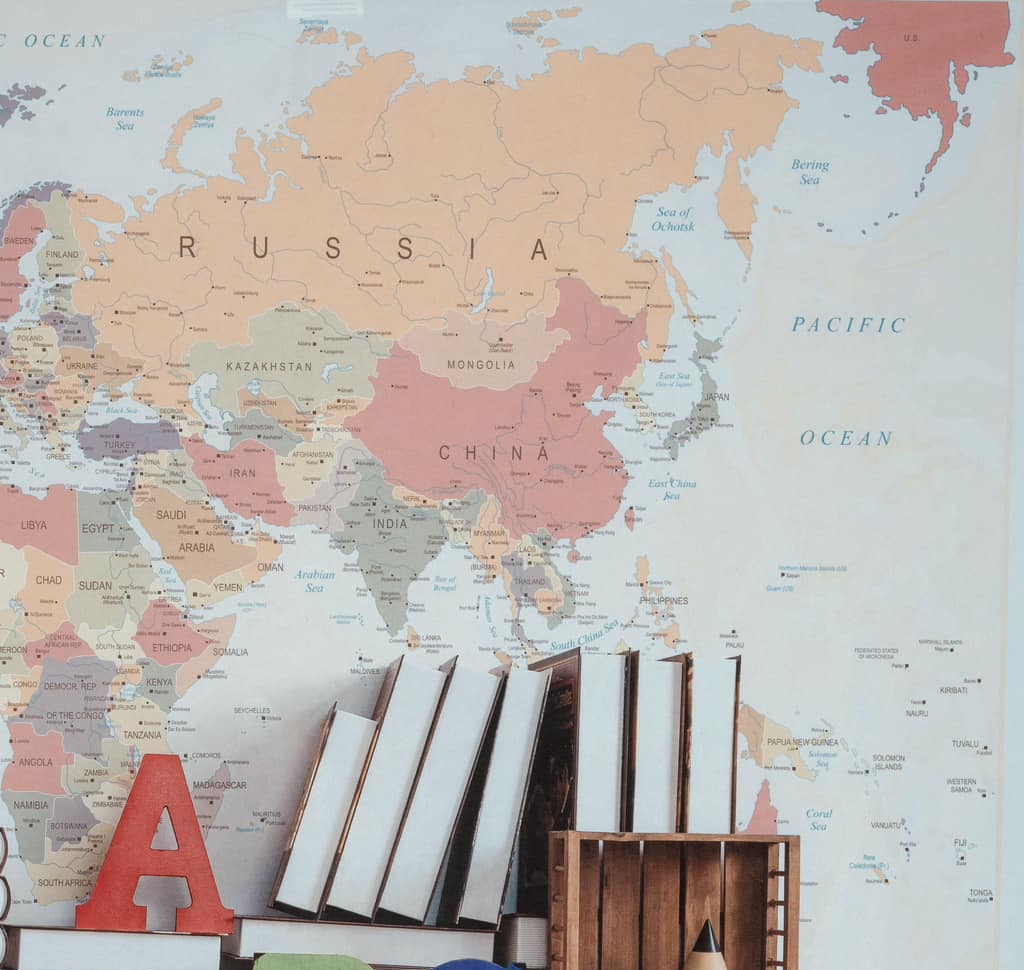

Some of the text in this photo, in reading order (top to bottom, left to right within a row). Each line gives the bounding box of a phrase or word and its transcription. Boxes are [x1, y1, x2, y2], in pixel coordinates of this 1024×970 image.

[24, 33, 107, 48] OCEAN
[106, 107, 144, 118] Barents
[116, 120, 134, 131] Sea
[792, 158, 830, 173] Bering
[800, 174, 820, 185] Sea
[657, 206, 693, 219] Sea of
[652, 220, 696, 233] Ochotsk
[179, 235, 548, 260] RUSSIA
[45, 251, 79, 259] FINLAND
[792, 316, 906, 333] PACIFIC
[226, 362, 313, 372] KAZAKHSTAN
[448, 361, 515, 369] MONGOLIA
[800, 430, 893, 446] OCEAN
[104, 441, 135, 449] TURKEY
[439, 445, 548, 461] CHINA
[230, 469, 256, 478] IRAN
[648, 479, 697, 488] East China
[664, 492, 680, 501] Sea
[298, 504, 332, 512] PAKISTAN
[156, 510, 186, 520] SAUDI
[21, 520, 47, 530] LIBYA
[373, 519, 408, 529] INDIA
[82, 524, 114, 534] EGYPT
[179, 543, 215, 553] ARABIA
[257, 563, 284, 572] OMAN
[294, 569, 336, 580] Arabian
[36, 576, 62, 585] CHAD
[79, 581, 112, 590] SUDAN
[213, 583, 243, 592] YEMEN
[305, 583, 324, 593] Sea
[640, 597, 689, 605] PHILIPPINES
[551, 619, 619, 652] South China Sea
[152, 643, 192, 653] ETHIOPIA
[213, 648, 248, 657] SOMALIA
[146, 678, 173, 687] KENYA
[47, 712, 105, 720] OF THE CONGO
[124, 731, 162, 739] TANZANIA
[767, 738, 839, 746] PAPUA NEW GUINEA
[19, 758, 53, 767] ANGOLA
[193, 781, 247, 790] MADAGASCAR
[13, 801, 48, 810] NAMIBIA
[806, 809, 833, 818] Coral
[810, 822, 827, 831] Sea
[75, 753, 234, 934] A
[954, 839, 967, 847] FIJI
[38, 879, 92, 887] SOUTH AFRICA
